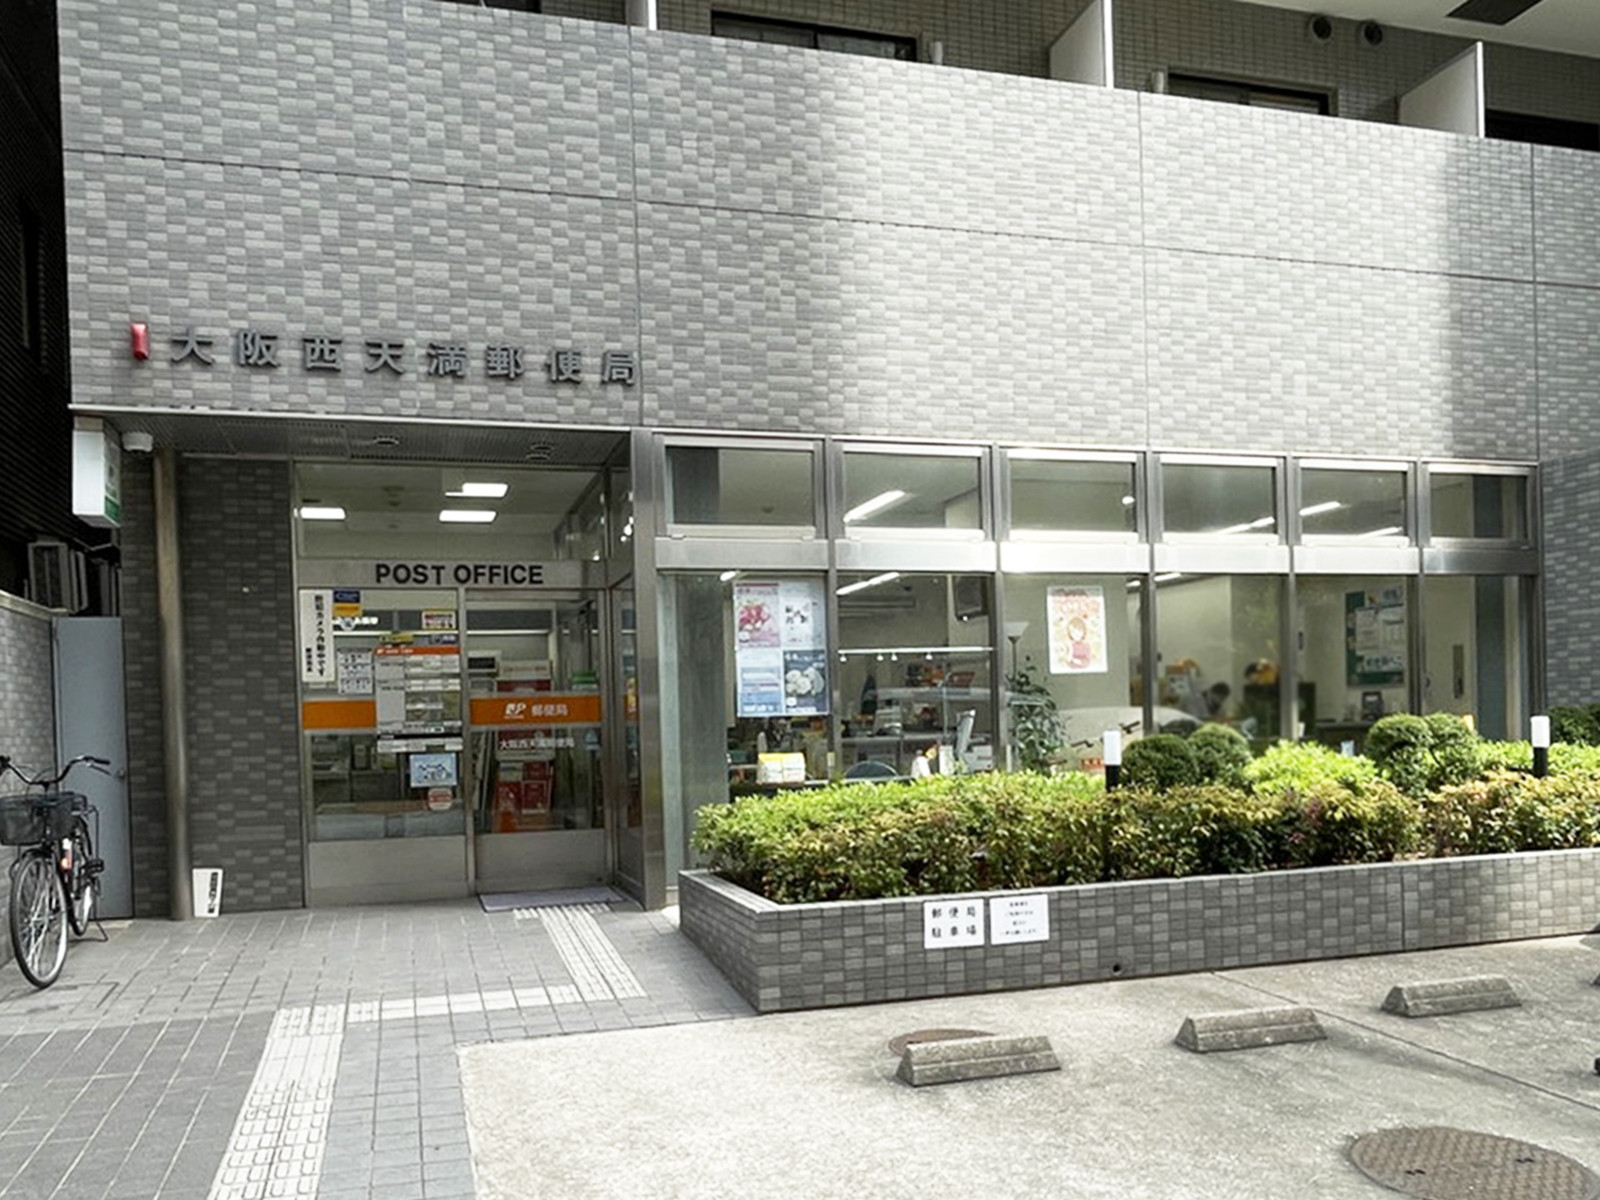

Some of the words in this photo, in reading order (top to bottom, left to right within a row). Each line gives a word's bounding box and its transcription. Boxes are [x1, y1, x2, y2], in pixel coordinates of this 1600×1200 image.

[171, 327, 636, 386] 大阪西天満郵便局
[375, 563, 446, 585] POST
[453, 564, 544, 585] OFFICE
[532, 704, 568, 716] 郵便局
[932, 906, 976, 919] 郵便局
[932, 925, 976, 938] 駐車場
